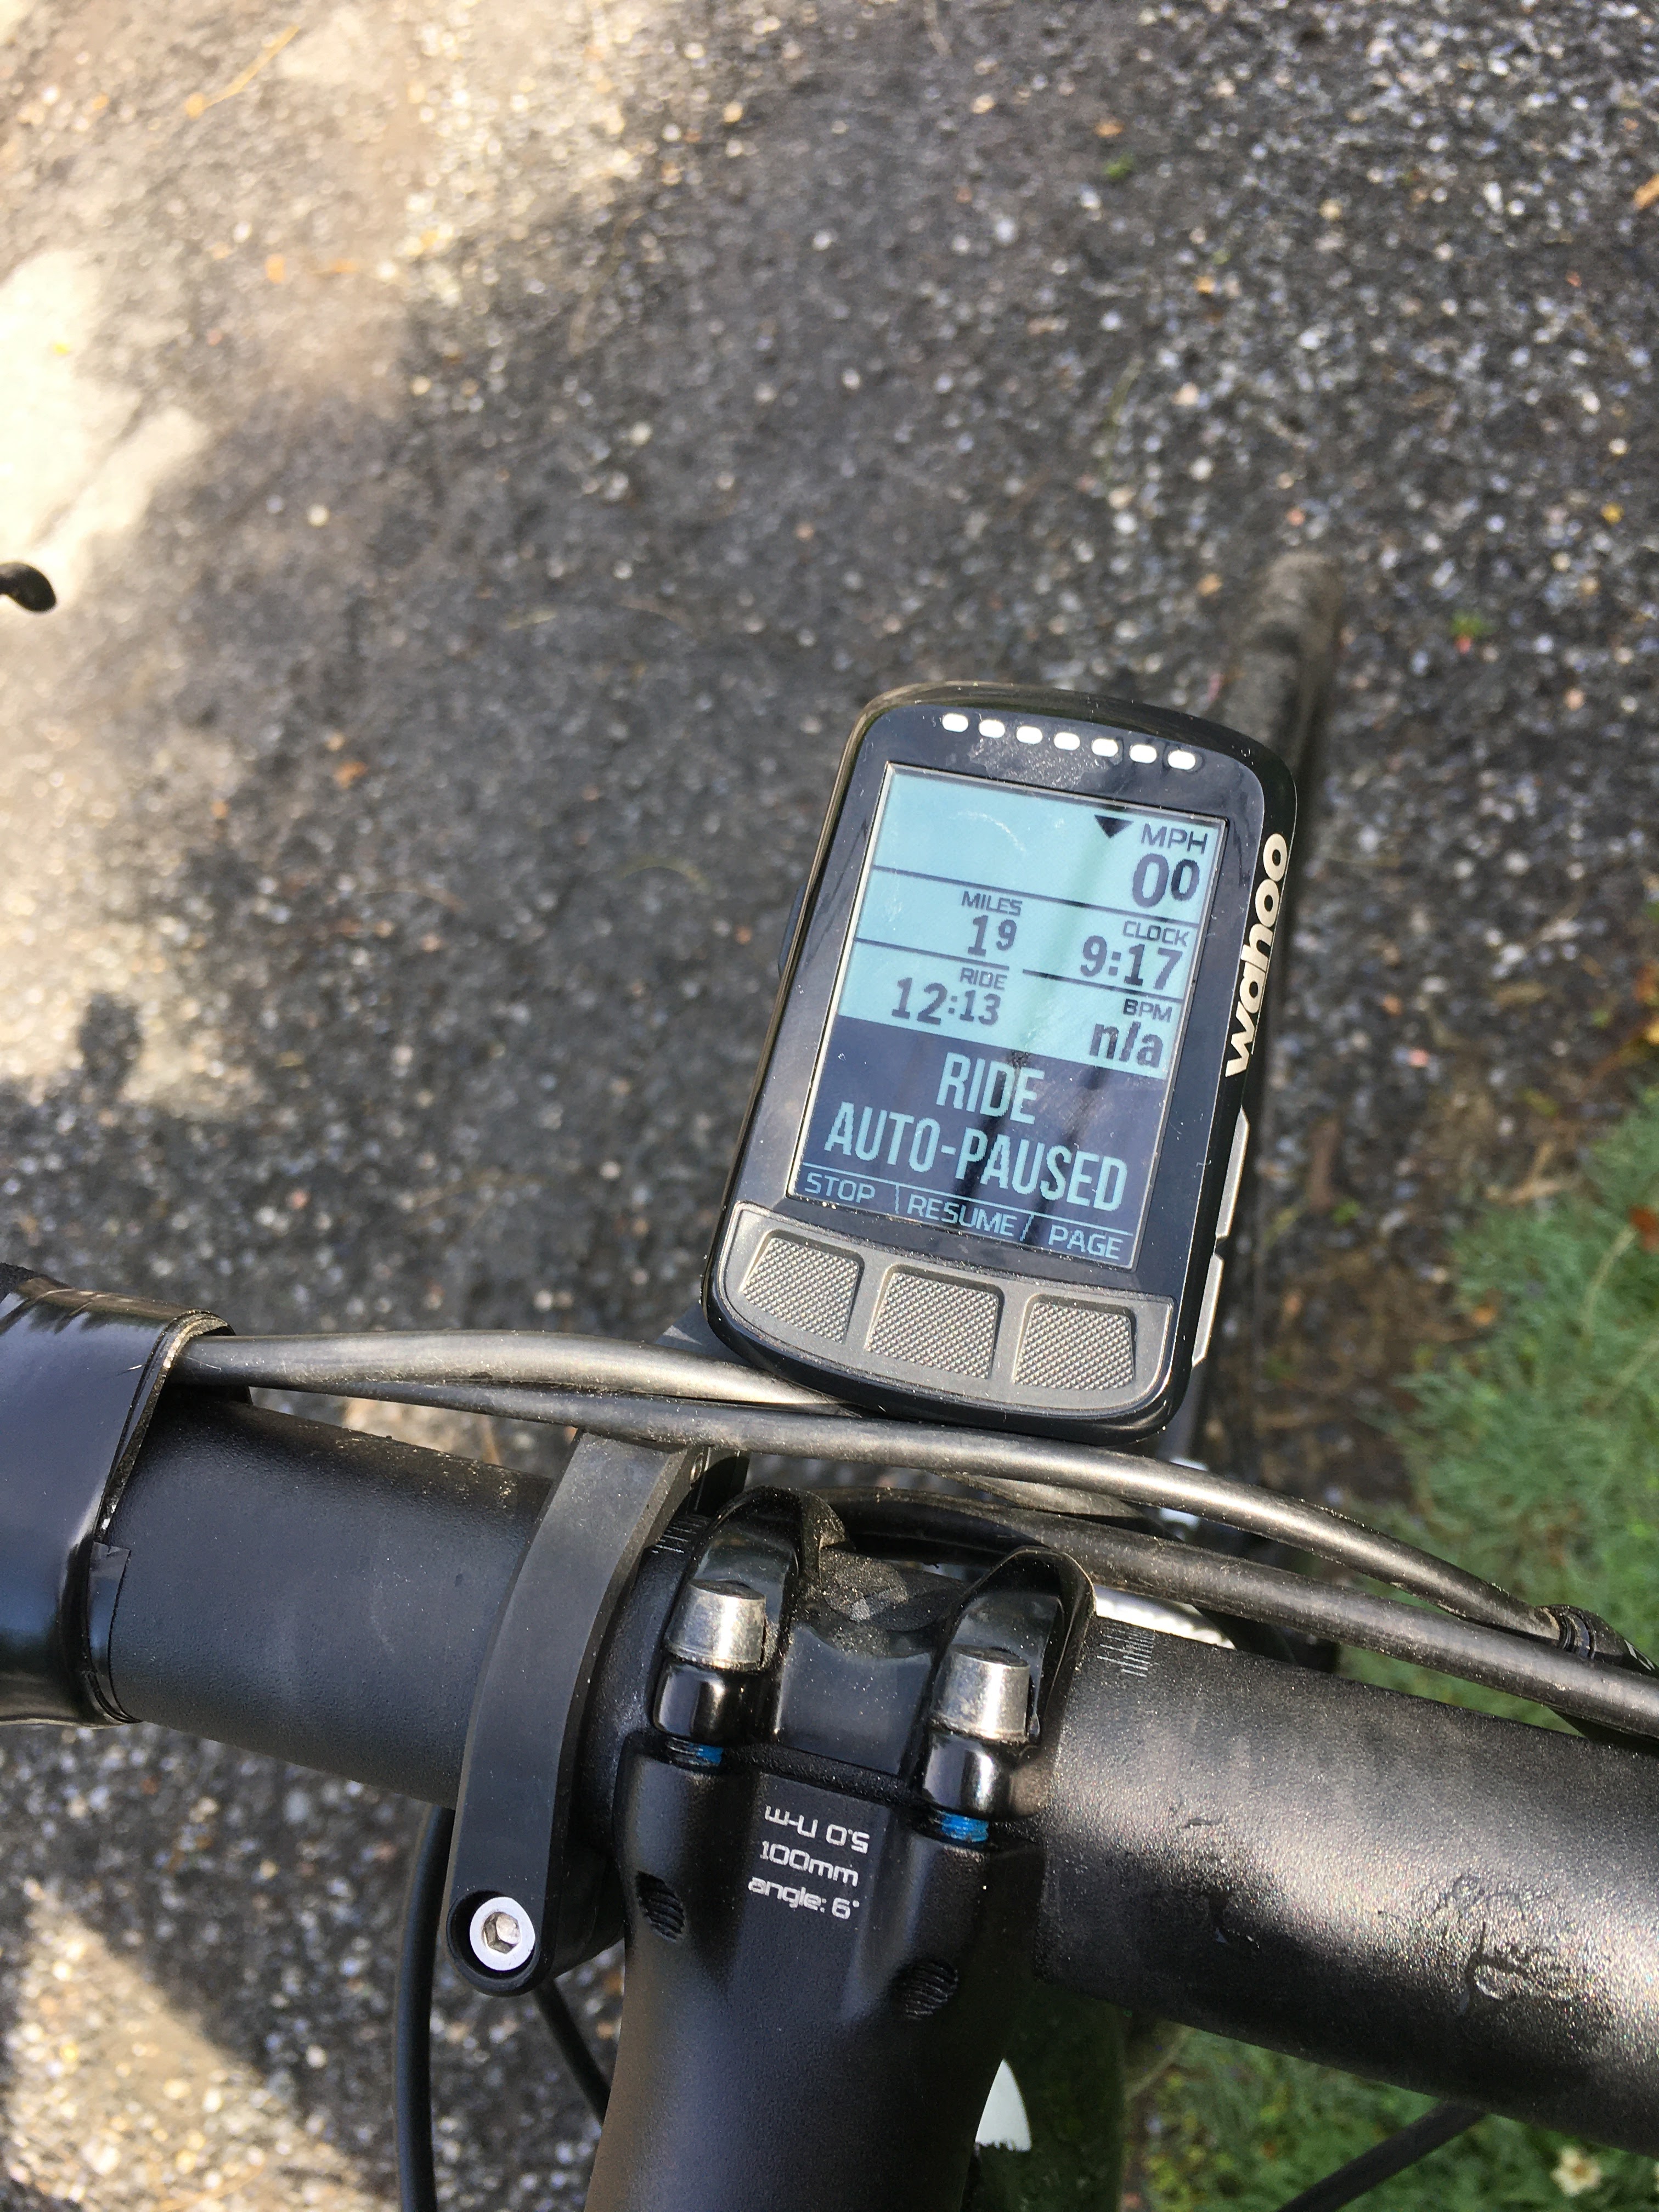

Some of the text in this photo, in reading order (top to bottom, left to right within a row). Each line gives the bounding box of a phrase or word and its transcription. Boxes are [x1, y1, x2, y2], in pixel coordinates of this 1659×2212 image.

[1141, 823, 1207, 854] MPH
[961, 891, 1023, 916] MILES
[1122, 921, 1190, 946] CLOCK
[1080, 935, 1183, 990] 9:17
[1225, 833, 1287, 1077] wahoo
[960, 967, 1007, 990] RIDE
[891, 977, 1001, 1025] 12:13
[1123, 998, 1172, 1023] BPM
[1089, 1022, 1164, 1068] n/a
[936, 1052, 1045, 1125] RIDE
[824, 1101, 1127, 1211] AUTO-PAUSED
[805, 1172, 876, 1203] STOP
[907, 1195, 1018, 1236] RESUME
[1048, 1224, 1124, 1260] PAGE
[826, 1824, 870, 1854] 5.0
[760, 1841, 859, 1887] 100mm
[748, 1876, 827, 1912] angle:
